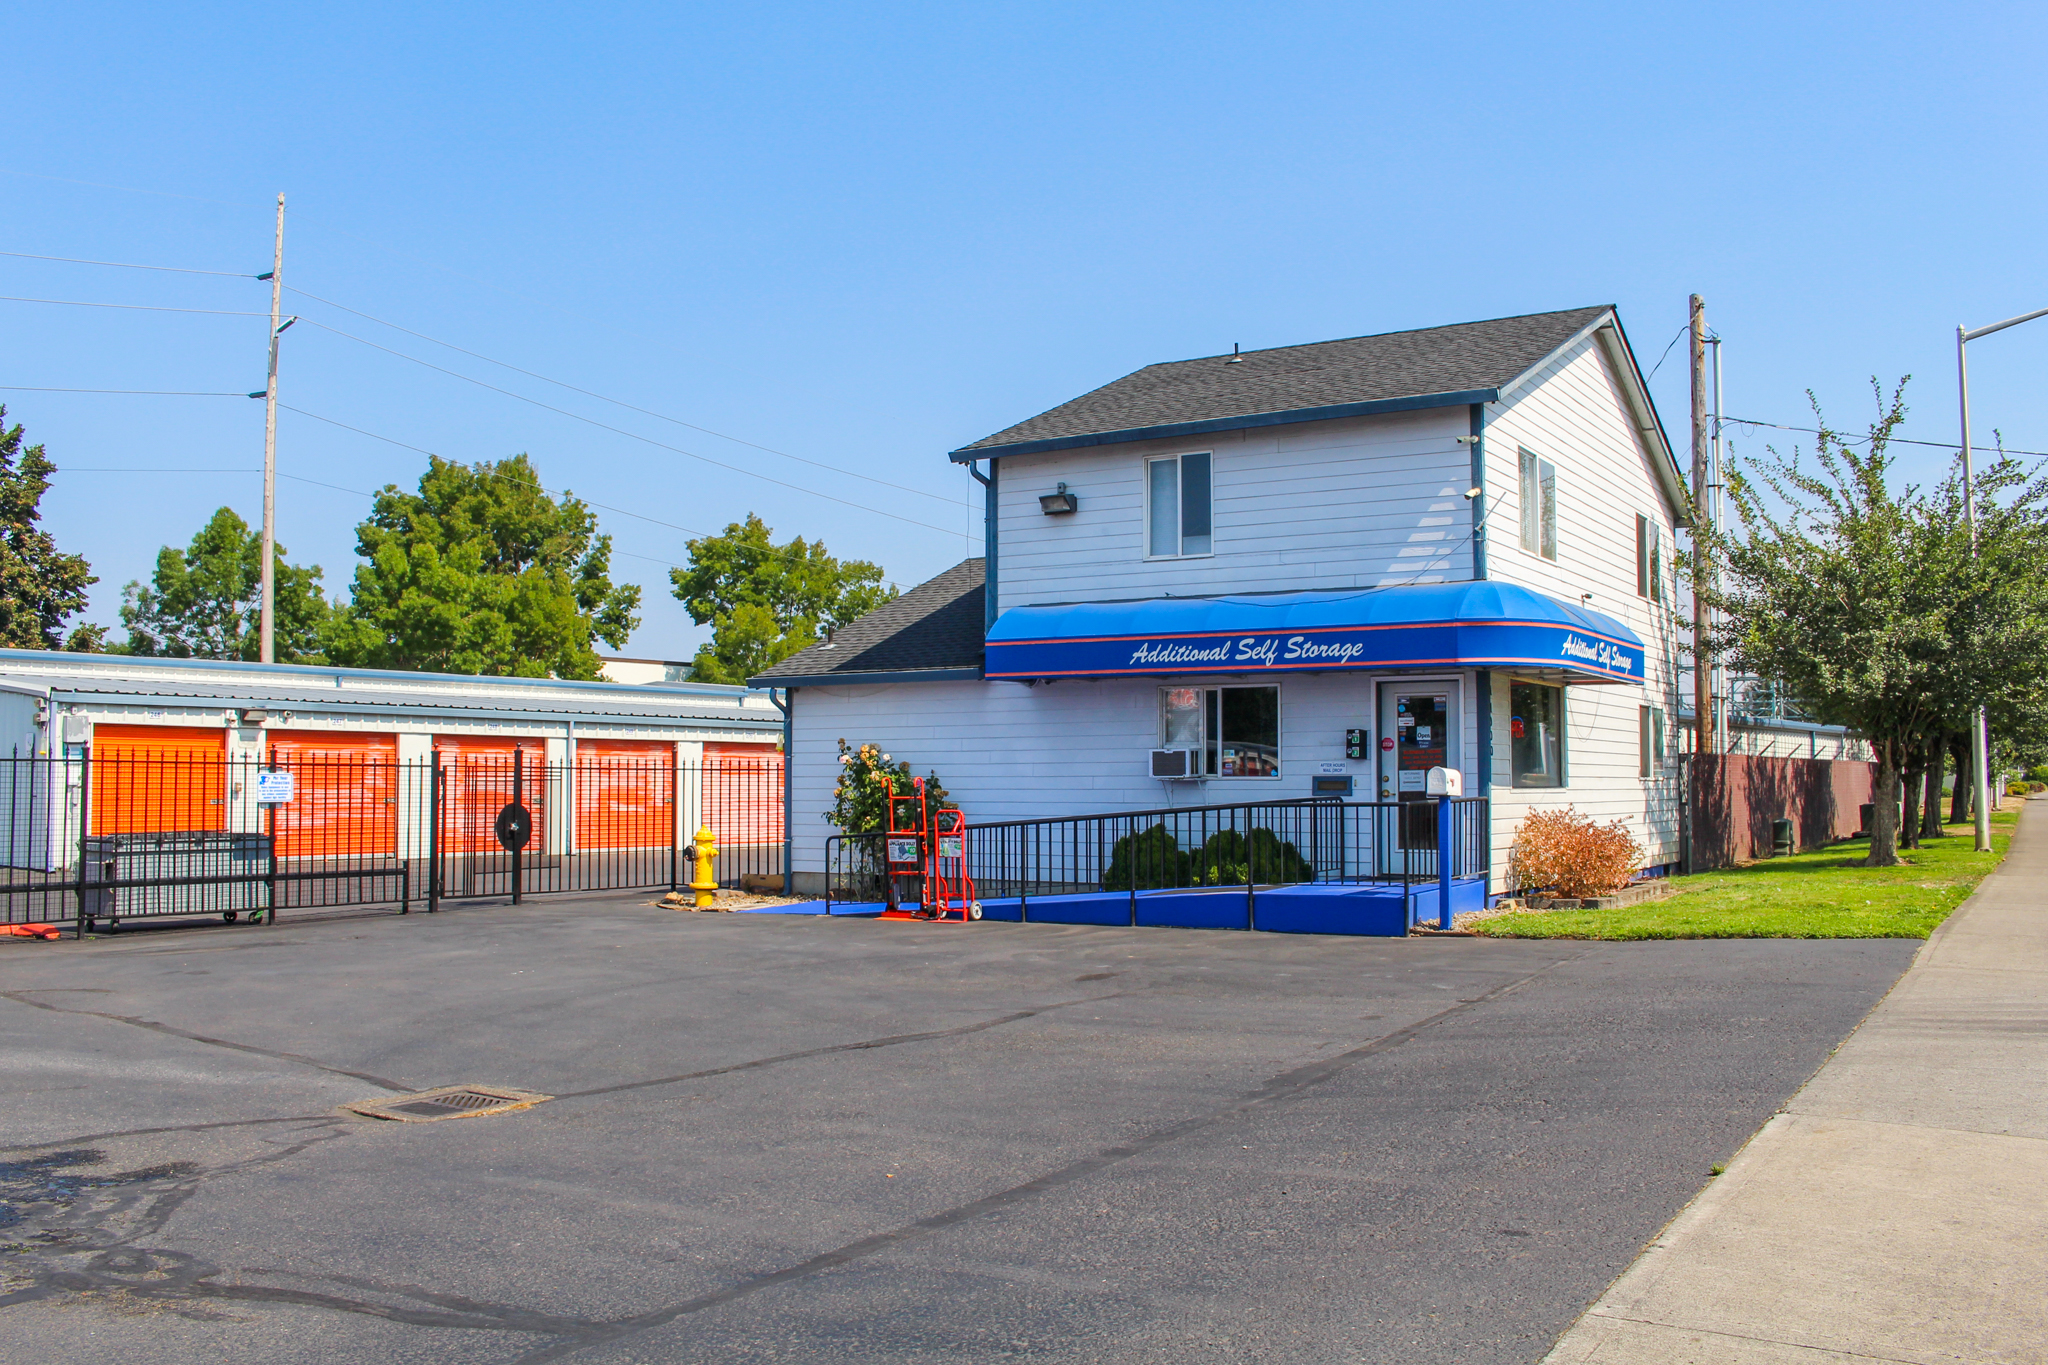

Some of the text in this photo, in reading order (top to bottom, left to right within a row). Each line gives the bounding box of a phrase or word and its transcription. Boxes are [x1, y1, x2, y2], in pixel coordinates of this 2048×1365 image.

[1129, 636, 1364, 666] Additional Self Storage
[1561, 633, 1632, 675] Additional Self Storage
